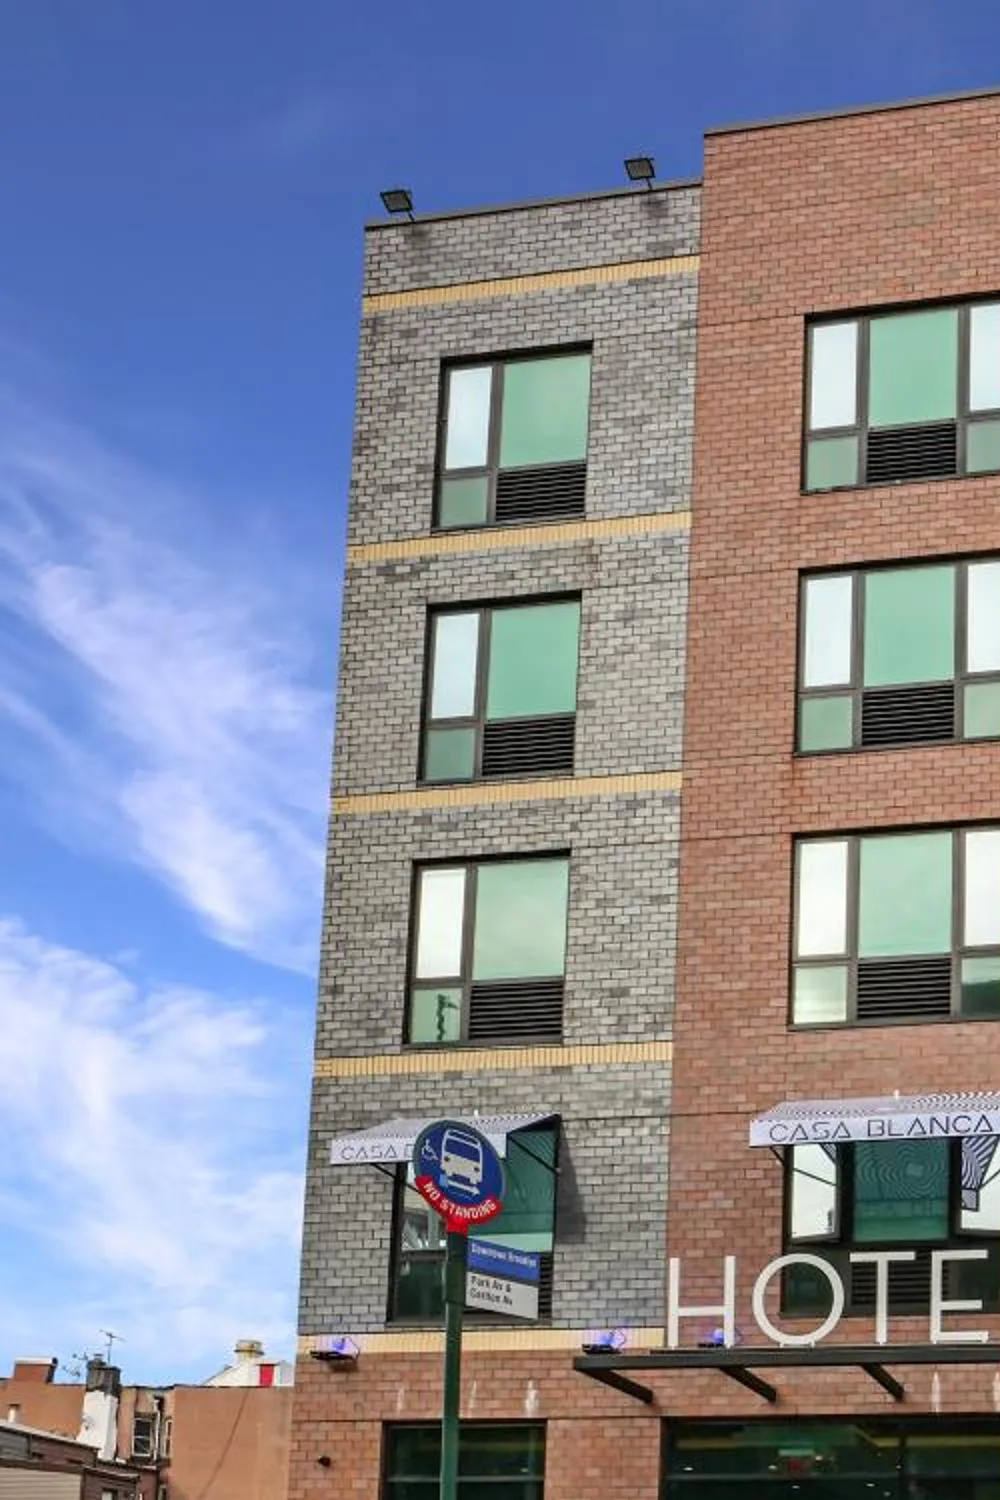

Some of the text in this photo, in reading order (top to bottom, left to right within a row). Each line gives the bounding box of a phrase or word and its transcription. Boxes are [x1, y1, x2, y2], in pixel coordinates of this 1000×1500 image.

[768, 1113, 994, 1143] CASA BLANCA
[340, 1144, 398, 1161] CASA
[423, 1181, 497, 1219] NO STANDING
